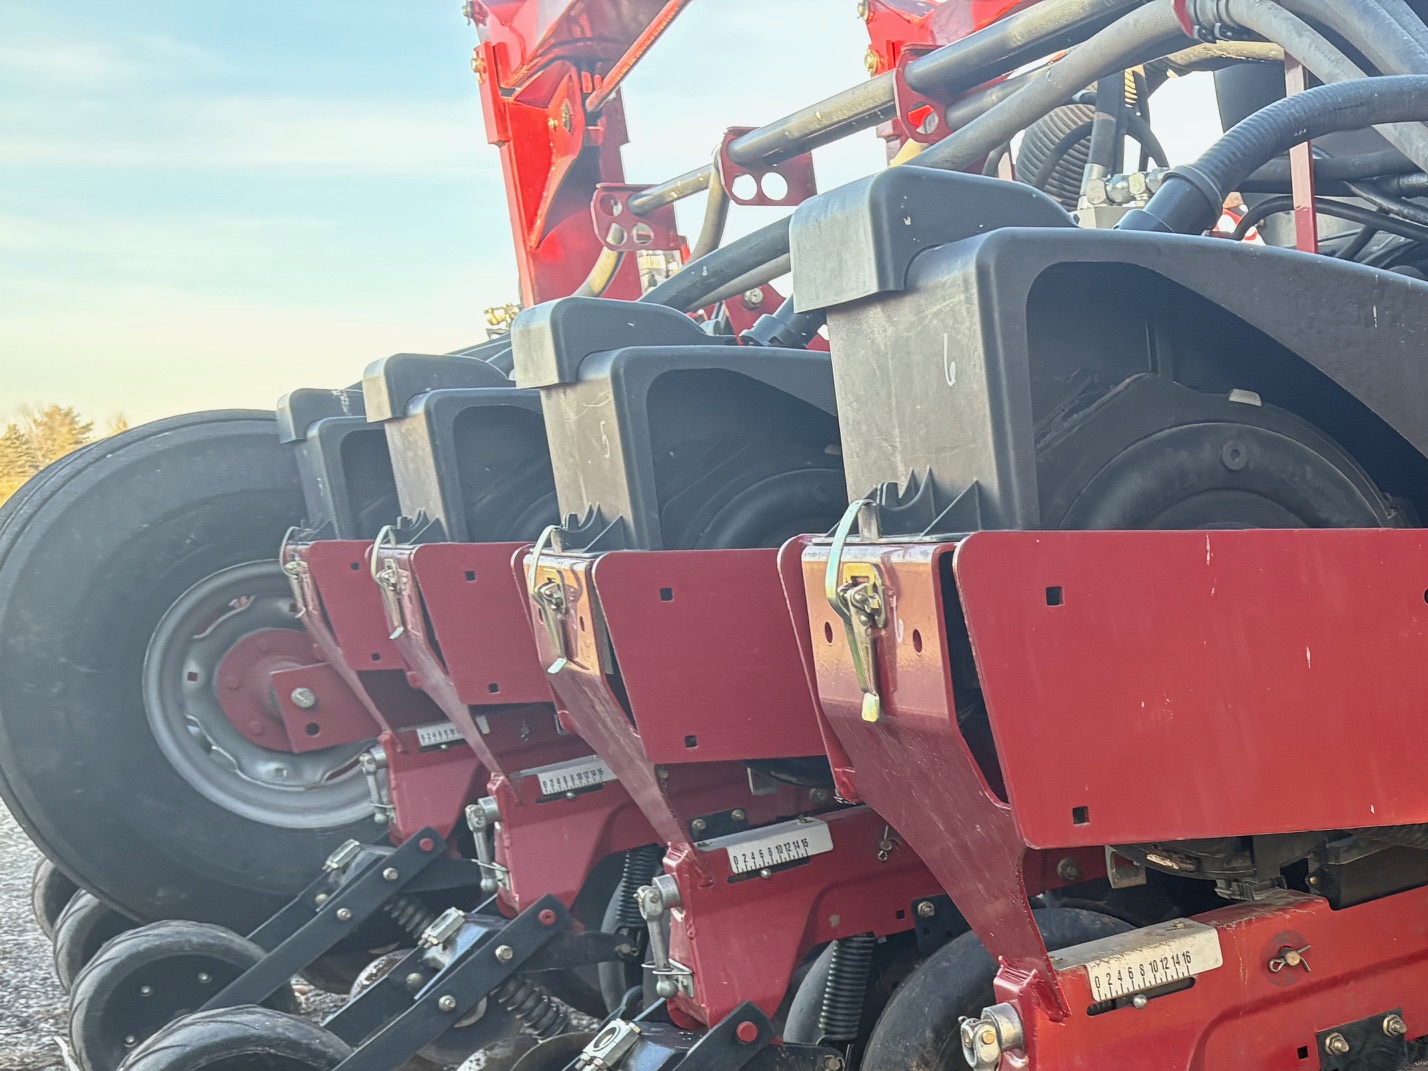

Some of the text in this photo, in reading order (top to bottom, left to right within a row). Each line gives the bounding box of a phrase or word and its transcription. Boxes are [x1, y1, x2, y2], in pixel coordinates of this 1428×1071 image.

[743, 854, 748, 863] 2
[1095, 951, 1192, 988] 0 2 4 6 8 10 12 14 16
